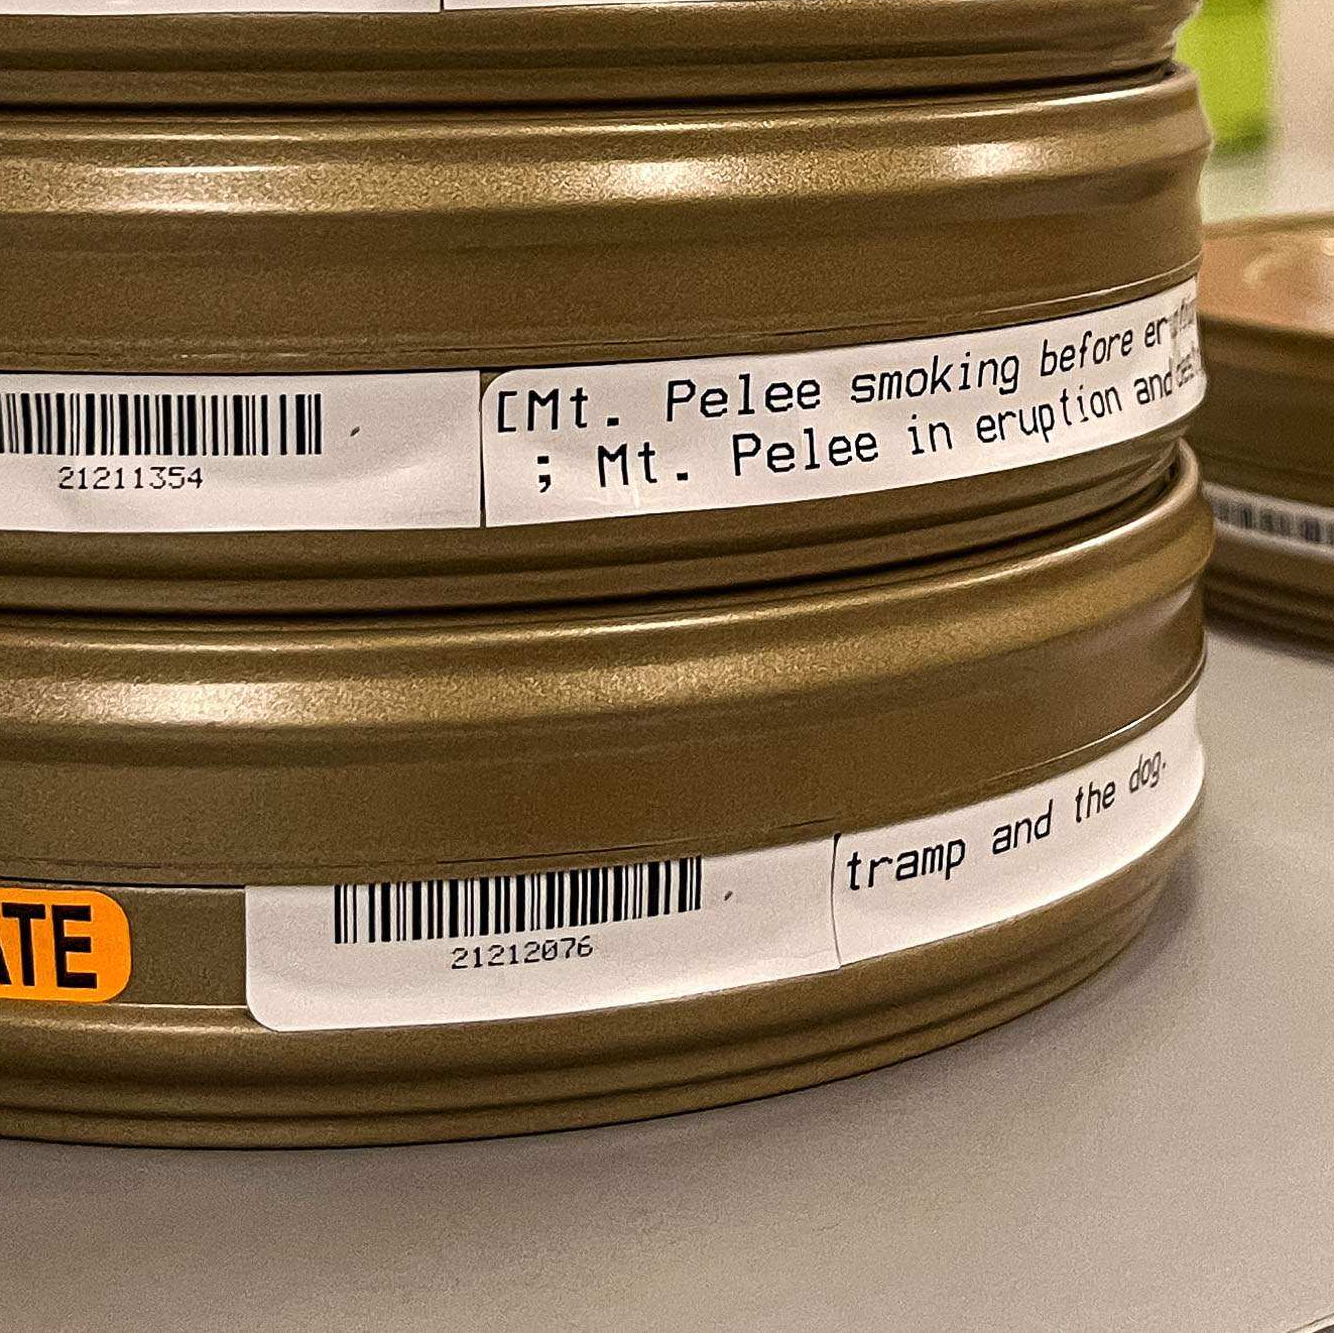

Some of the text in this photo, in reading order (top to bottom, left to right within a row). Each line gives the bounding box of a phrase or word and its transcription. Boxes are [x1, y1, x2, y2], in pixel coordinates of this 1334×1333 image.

[497, 386, 620, 433] [Mt.
[666, 373, 821, 422] Pelee
[850, 351, 1020, 404] smoking
[1040, 330, 1134, 377] before
[58, 465, 203, 490] 21211354
[597, 441, 690, 488] Mt.
[732, 427, 879, 477] Pelee
[908, 413, 954, 456] in
[976, 383, 1123, 444] eruption
[846, 750, 1166, 892] tramp and the dog.
[450, 935, 594, 970] 21212076
